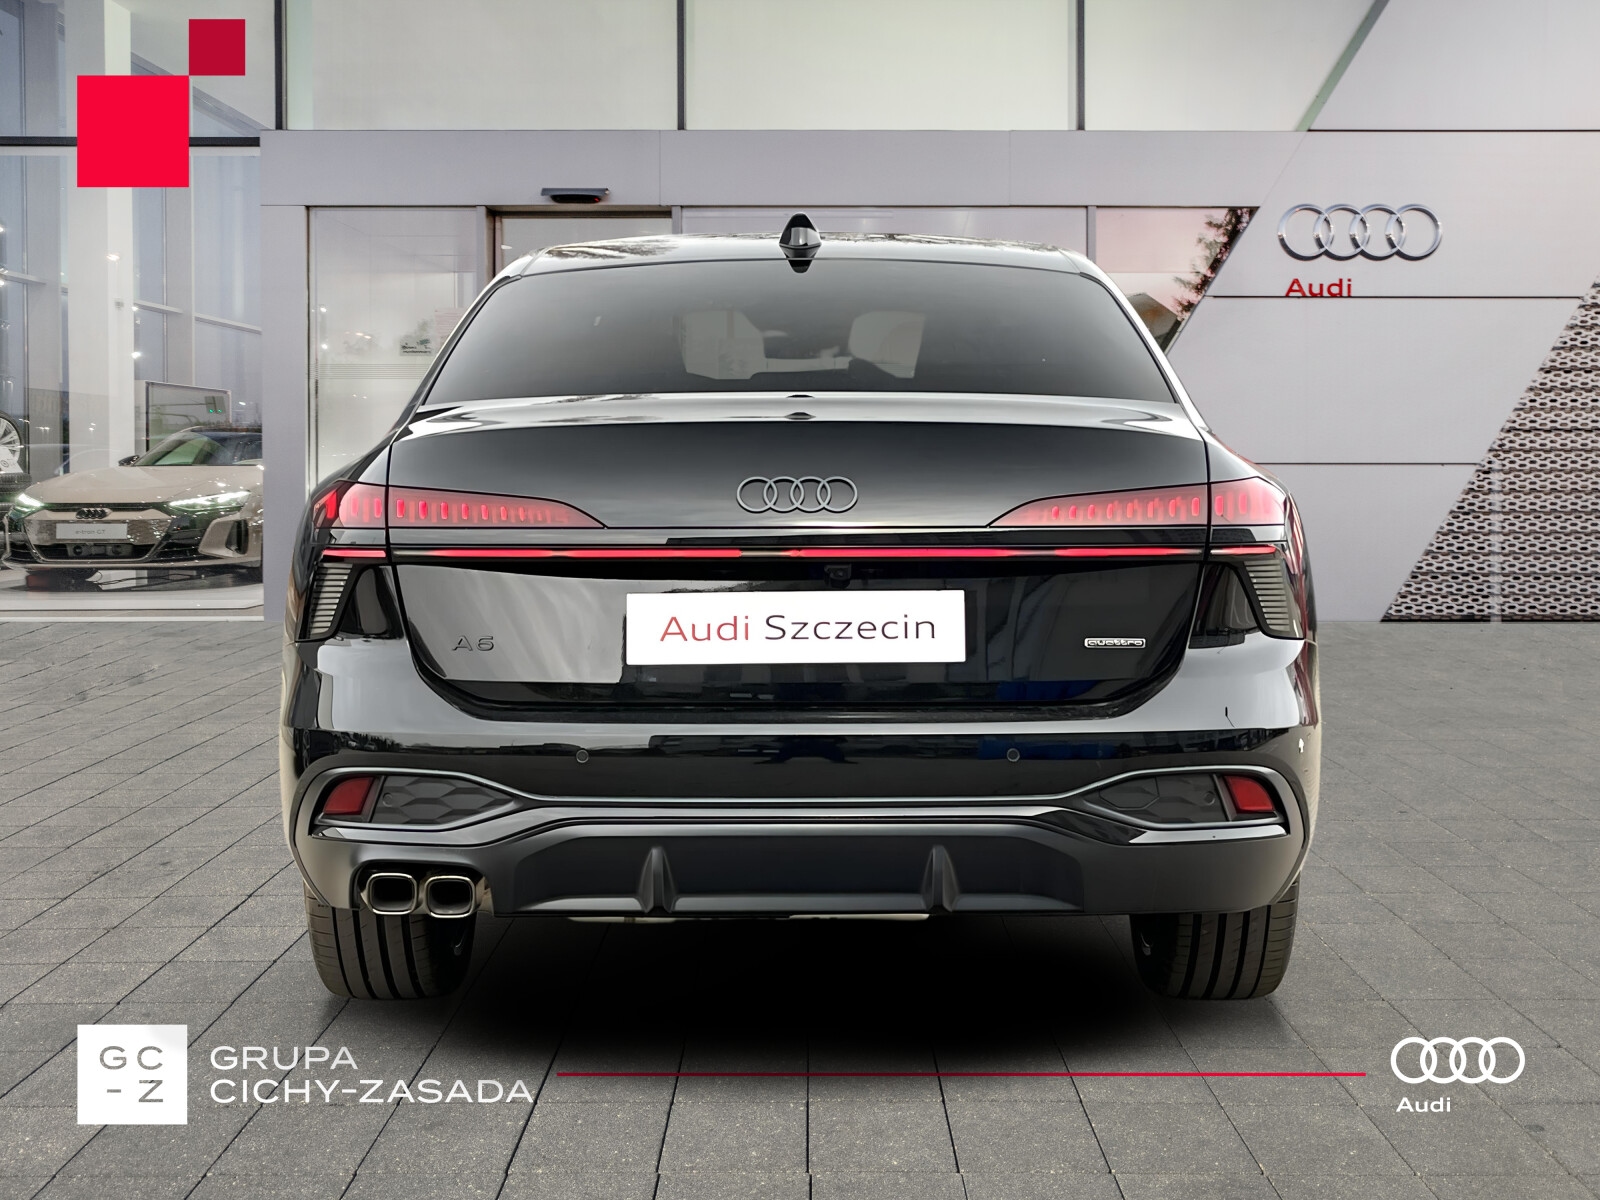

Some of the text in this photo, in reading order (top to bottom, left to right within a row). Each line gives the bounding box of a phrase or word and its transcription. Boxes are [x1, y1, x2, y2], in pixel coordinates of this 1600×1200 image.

[1284, 278, 1353, 297] Audi
[659, 614, 936, 642] Audi Szczecin
[451, 634, 495, 652] A6
[1086, 638, 1144, 648] quattro
